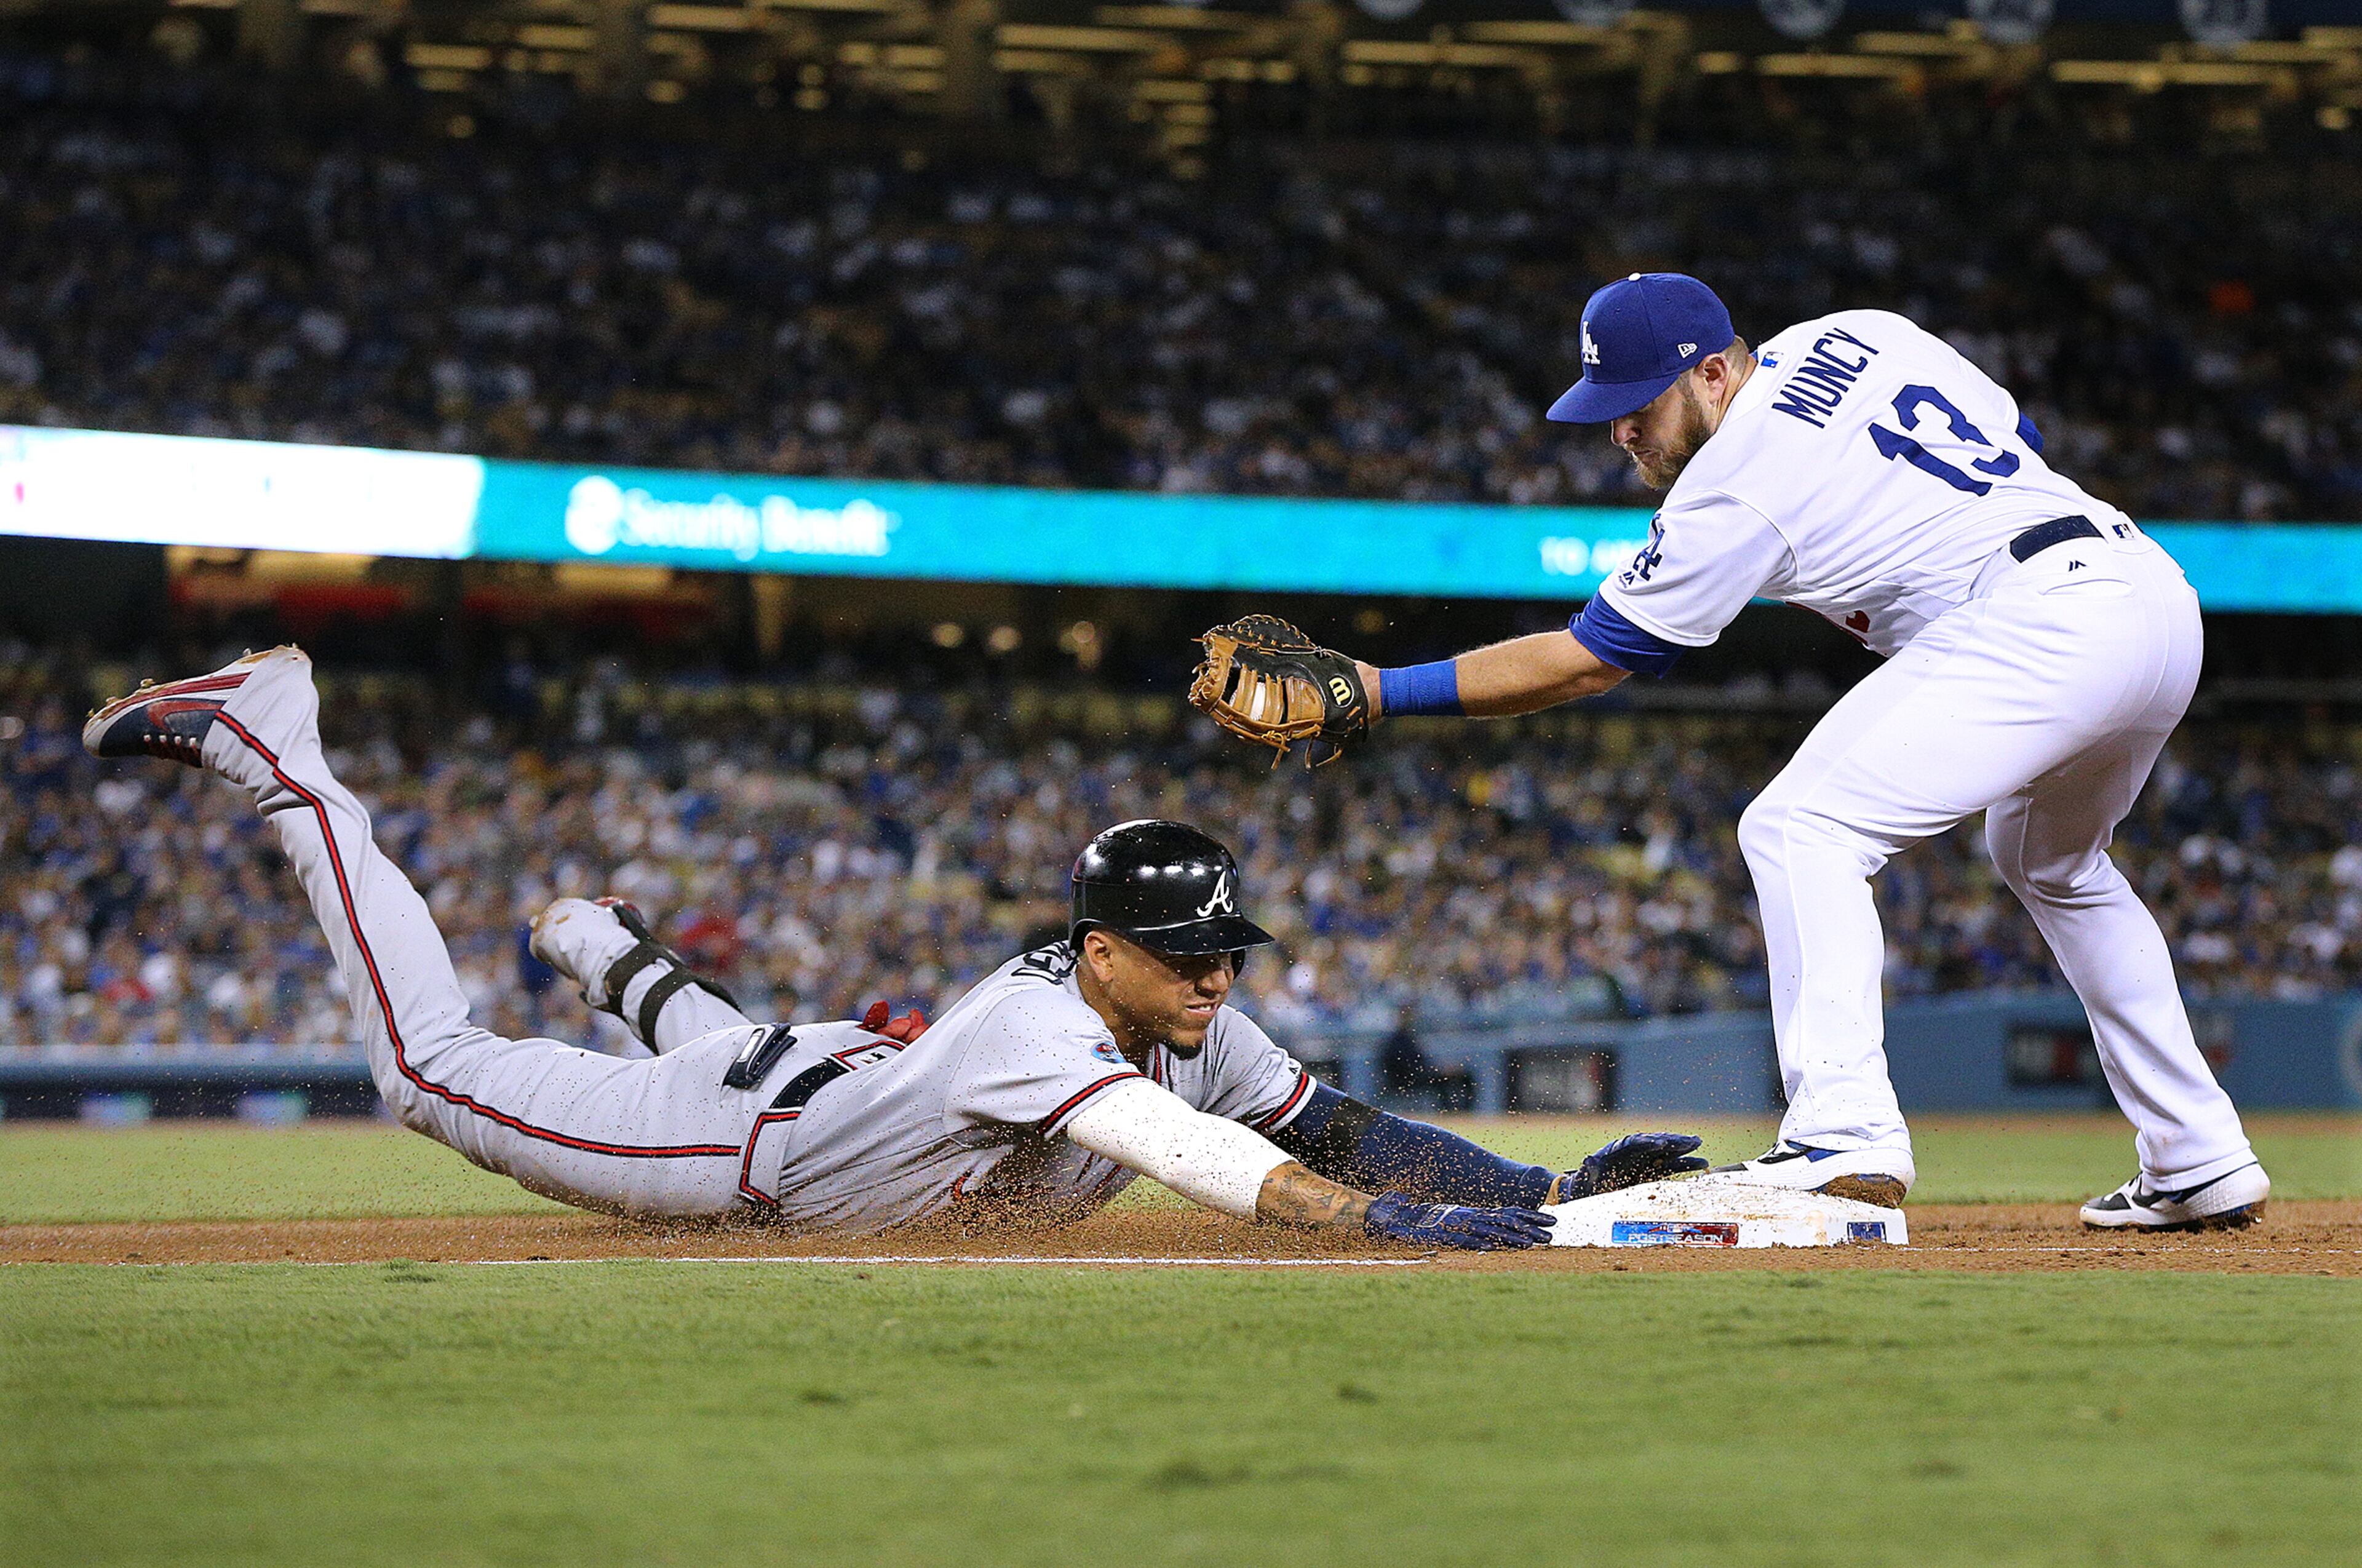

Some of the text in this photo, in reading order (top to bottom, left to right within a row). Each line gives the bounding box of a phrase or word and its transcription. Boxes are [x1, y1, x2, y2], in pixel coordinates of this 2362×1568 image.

[1582, 321, 1601, 365] LA
[1772, 327, 1879, 429] MUNCY
[1867, 384, 2020, 496] 13
[1197, 871, 1232, 917] A
[1628, 1233, 1723, 1244] POSTSEASON
